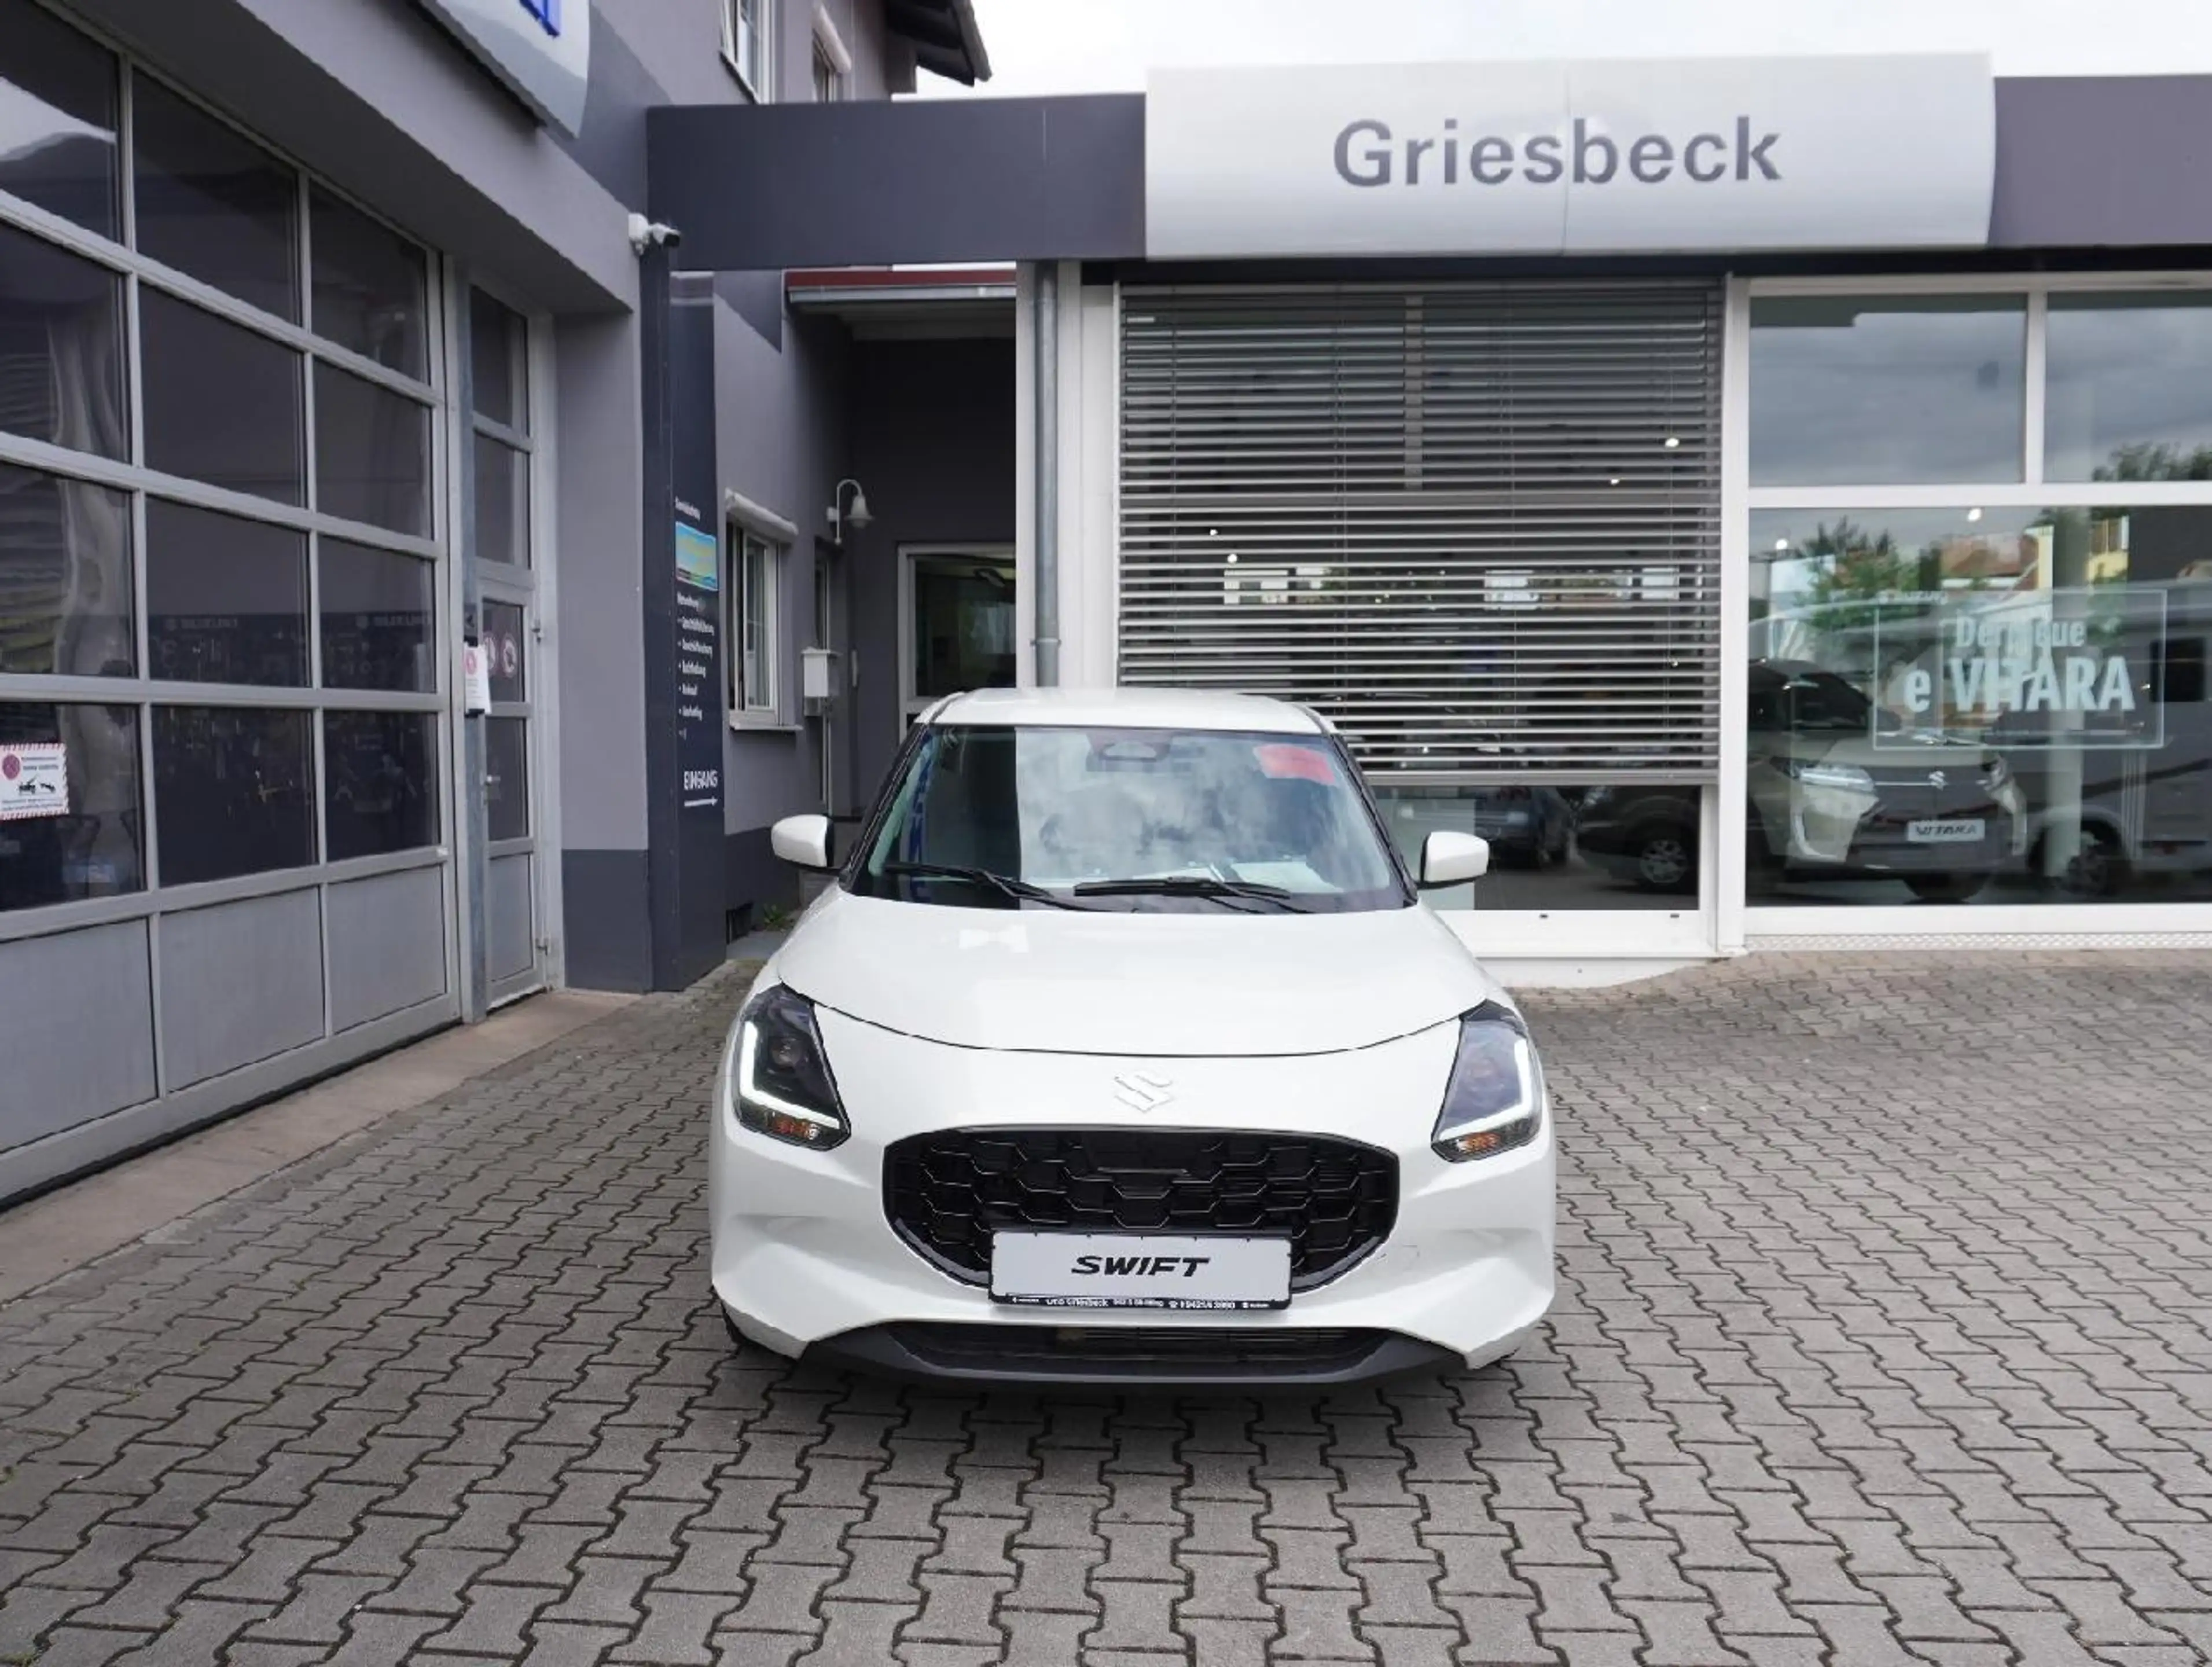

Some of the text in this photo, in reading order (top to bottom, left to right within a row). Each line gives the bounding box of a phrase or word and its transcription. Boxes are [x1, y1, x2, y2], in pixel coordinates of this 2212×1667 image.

[1332, 116, 1783, 186] Griesbeck
[1956, 616, 2004, 647] Der
[1904, 668, 1932, 713] e
[684, 769, 718, 791] EINGANG
[1071, 1255, 1211, 1277] SWIFT
